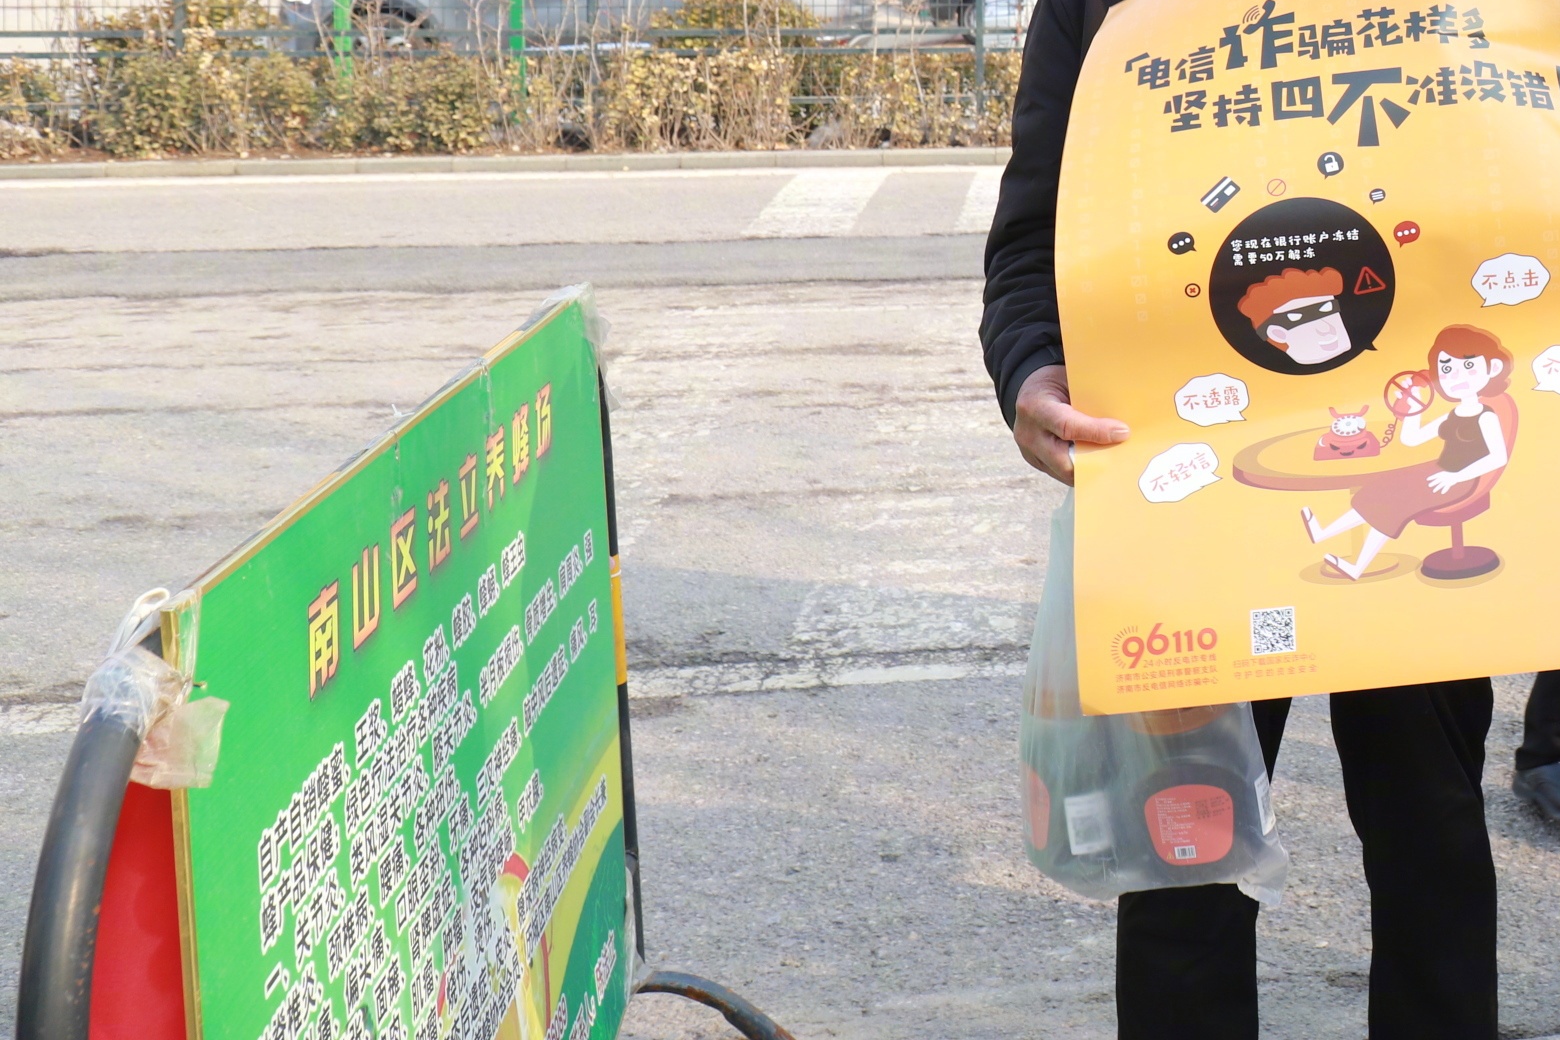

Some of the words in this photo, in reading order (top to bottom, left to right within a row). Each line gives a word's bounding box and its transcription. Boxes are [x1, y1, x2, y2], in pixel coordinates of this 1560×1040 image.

[1231, 228, 1360, 252] 您现在银行账户冻结
[1232, 247, 1316, 267] 需要50万解冻
[1481, 269, 1540, 291] 不点击
[1182, 386, 1242, 410] 不透露
[1149, 450, 1212, 494] 不轻信
[307, 381, 552, 701] 南山区法立养蜂场
[1121, 622, 1218, 669] 96110
